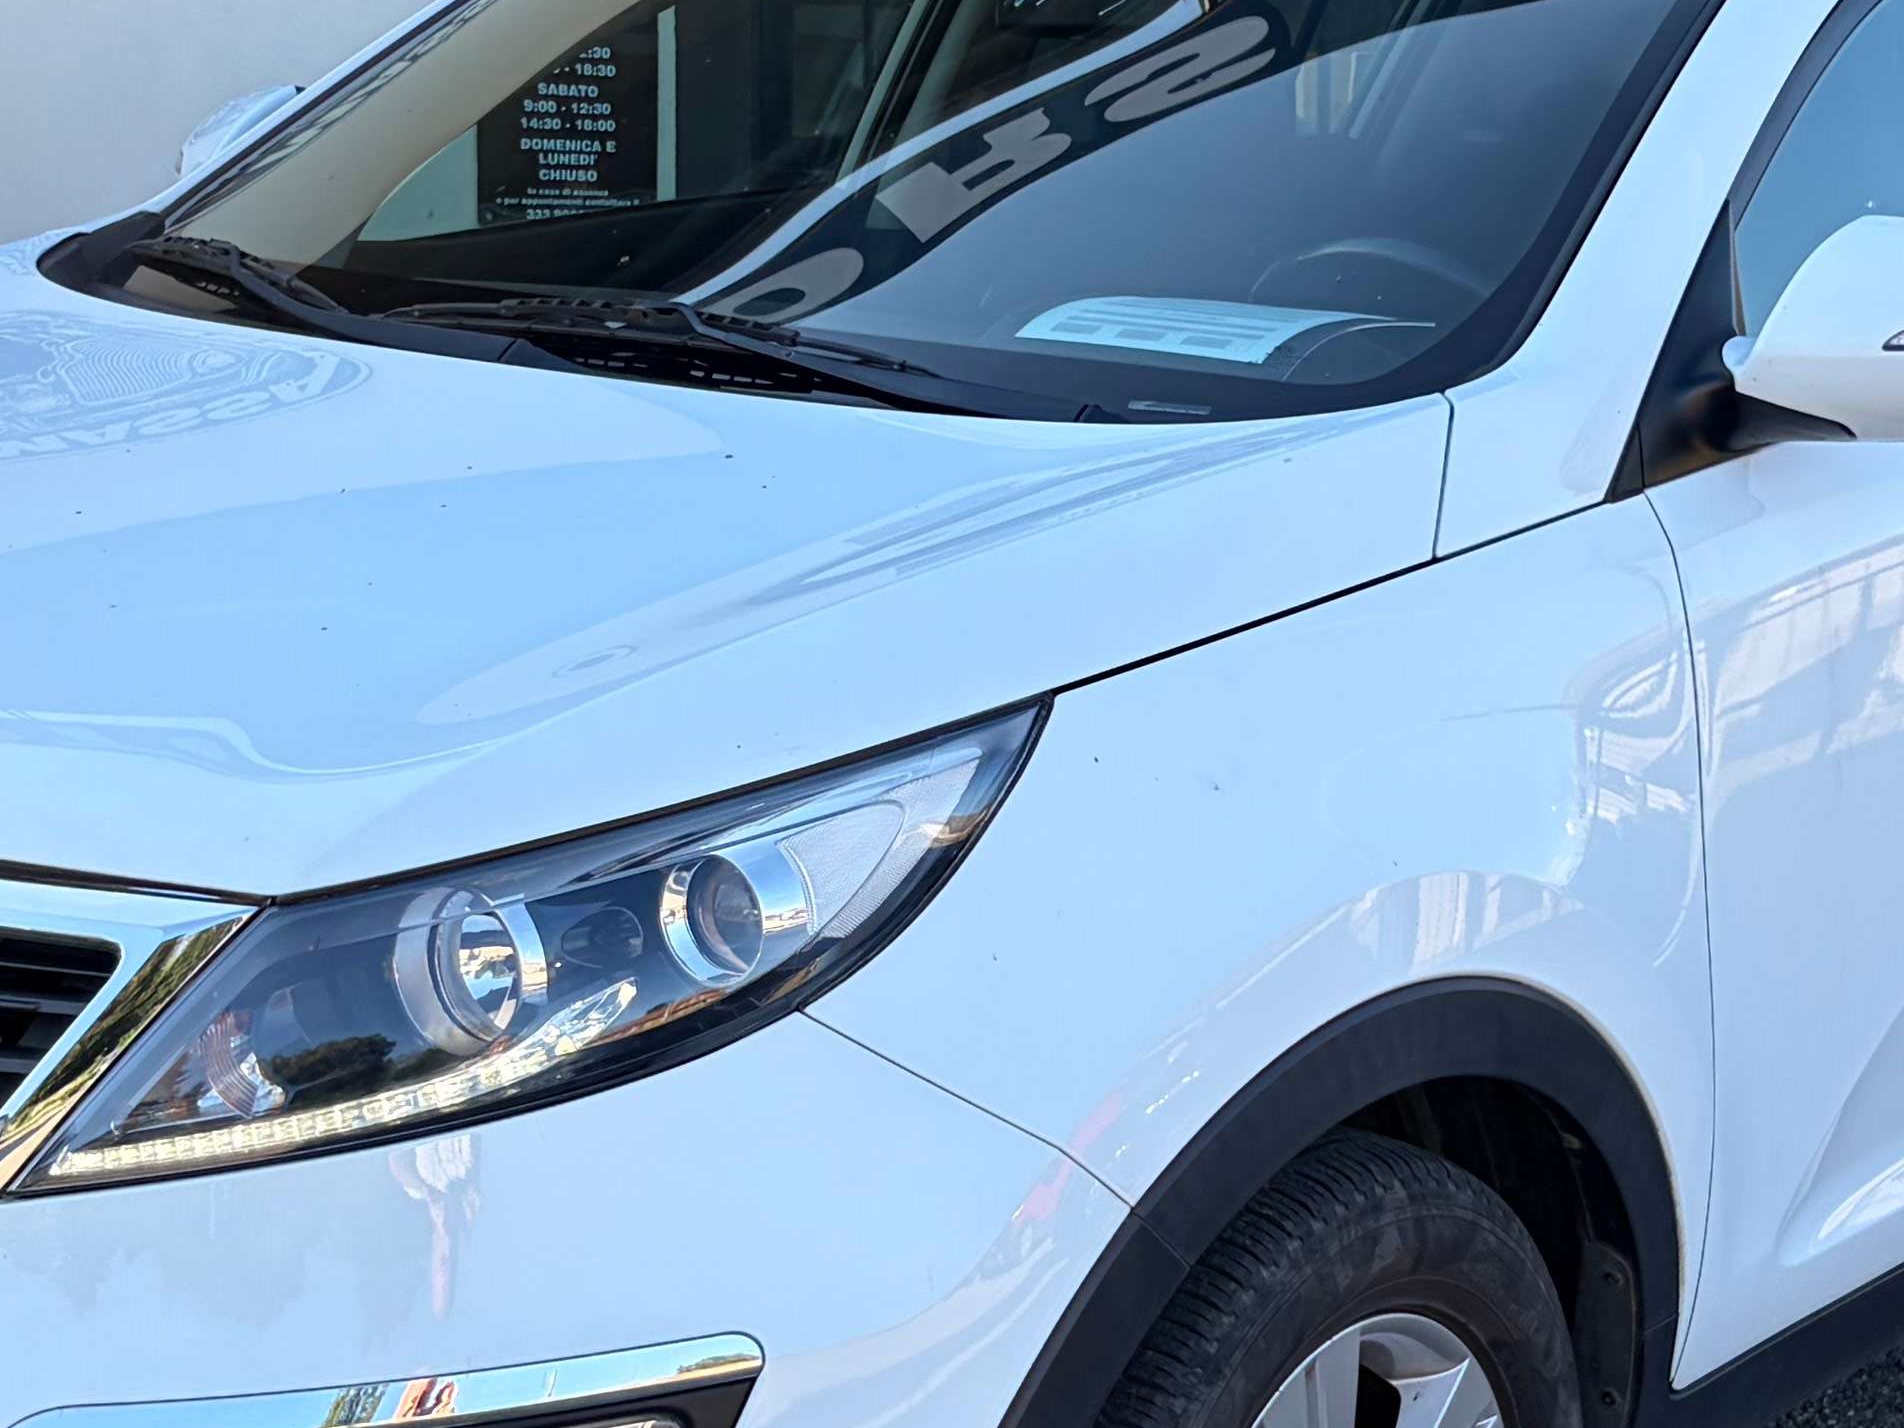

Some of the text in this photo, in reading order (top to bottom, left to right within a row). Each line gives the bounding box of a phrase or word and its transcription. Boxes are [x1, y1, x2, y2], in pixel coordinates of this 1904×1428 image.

[537, 82, 599, 98] SABATO
[523, 99, 557, 113] 9:00
[571, 102, 611, 115] 12:30
[520, 117, 561, 130] 14:30
[520, 137, 617, 153] DOMENICA E
[538, 168, 598, 182] CHIUSO
